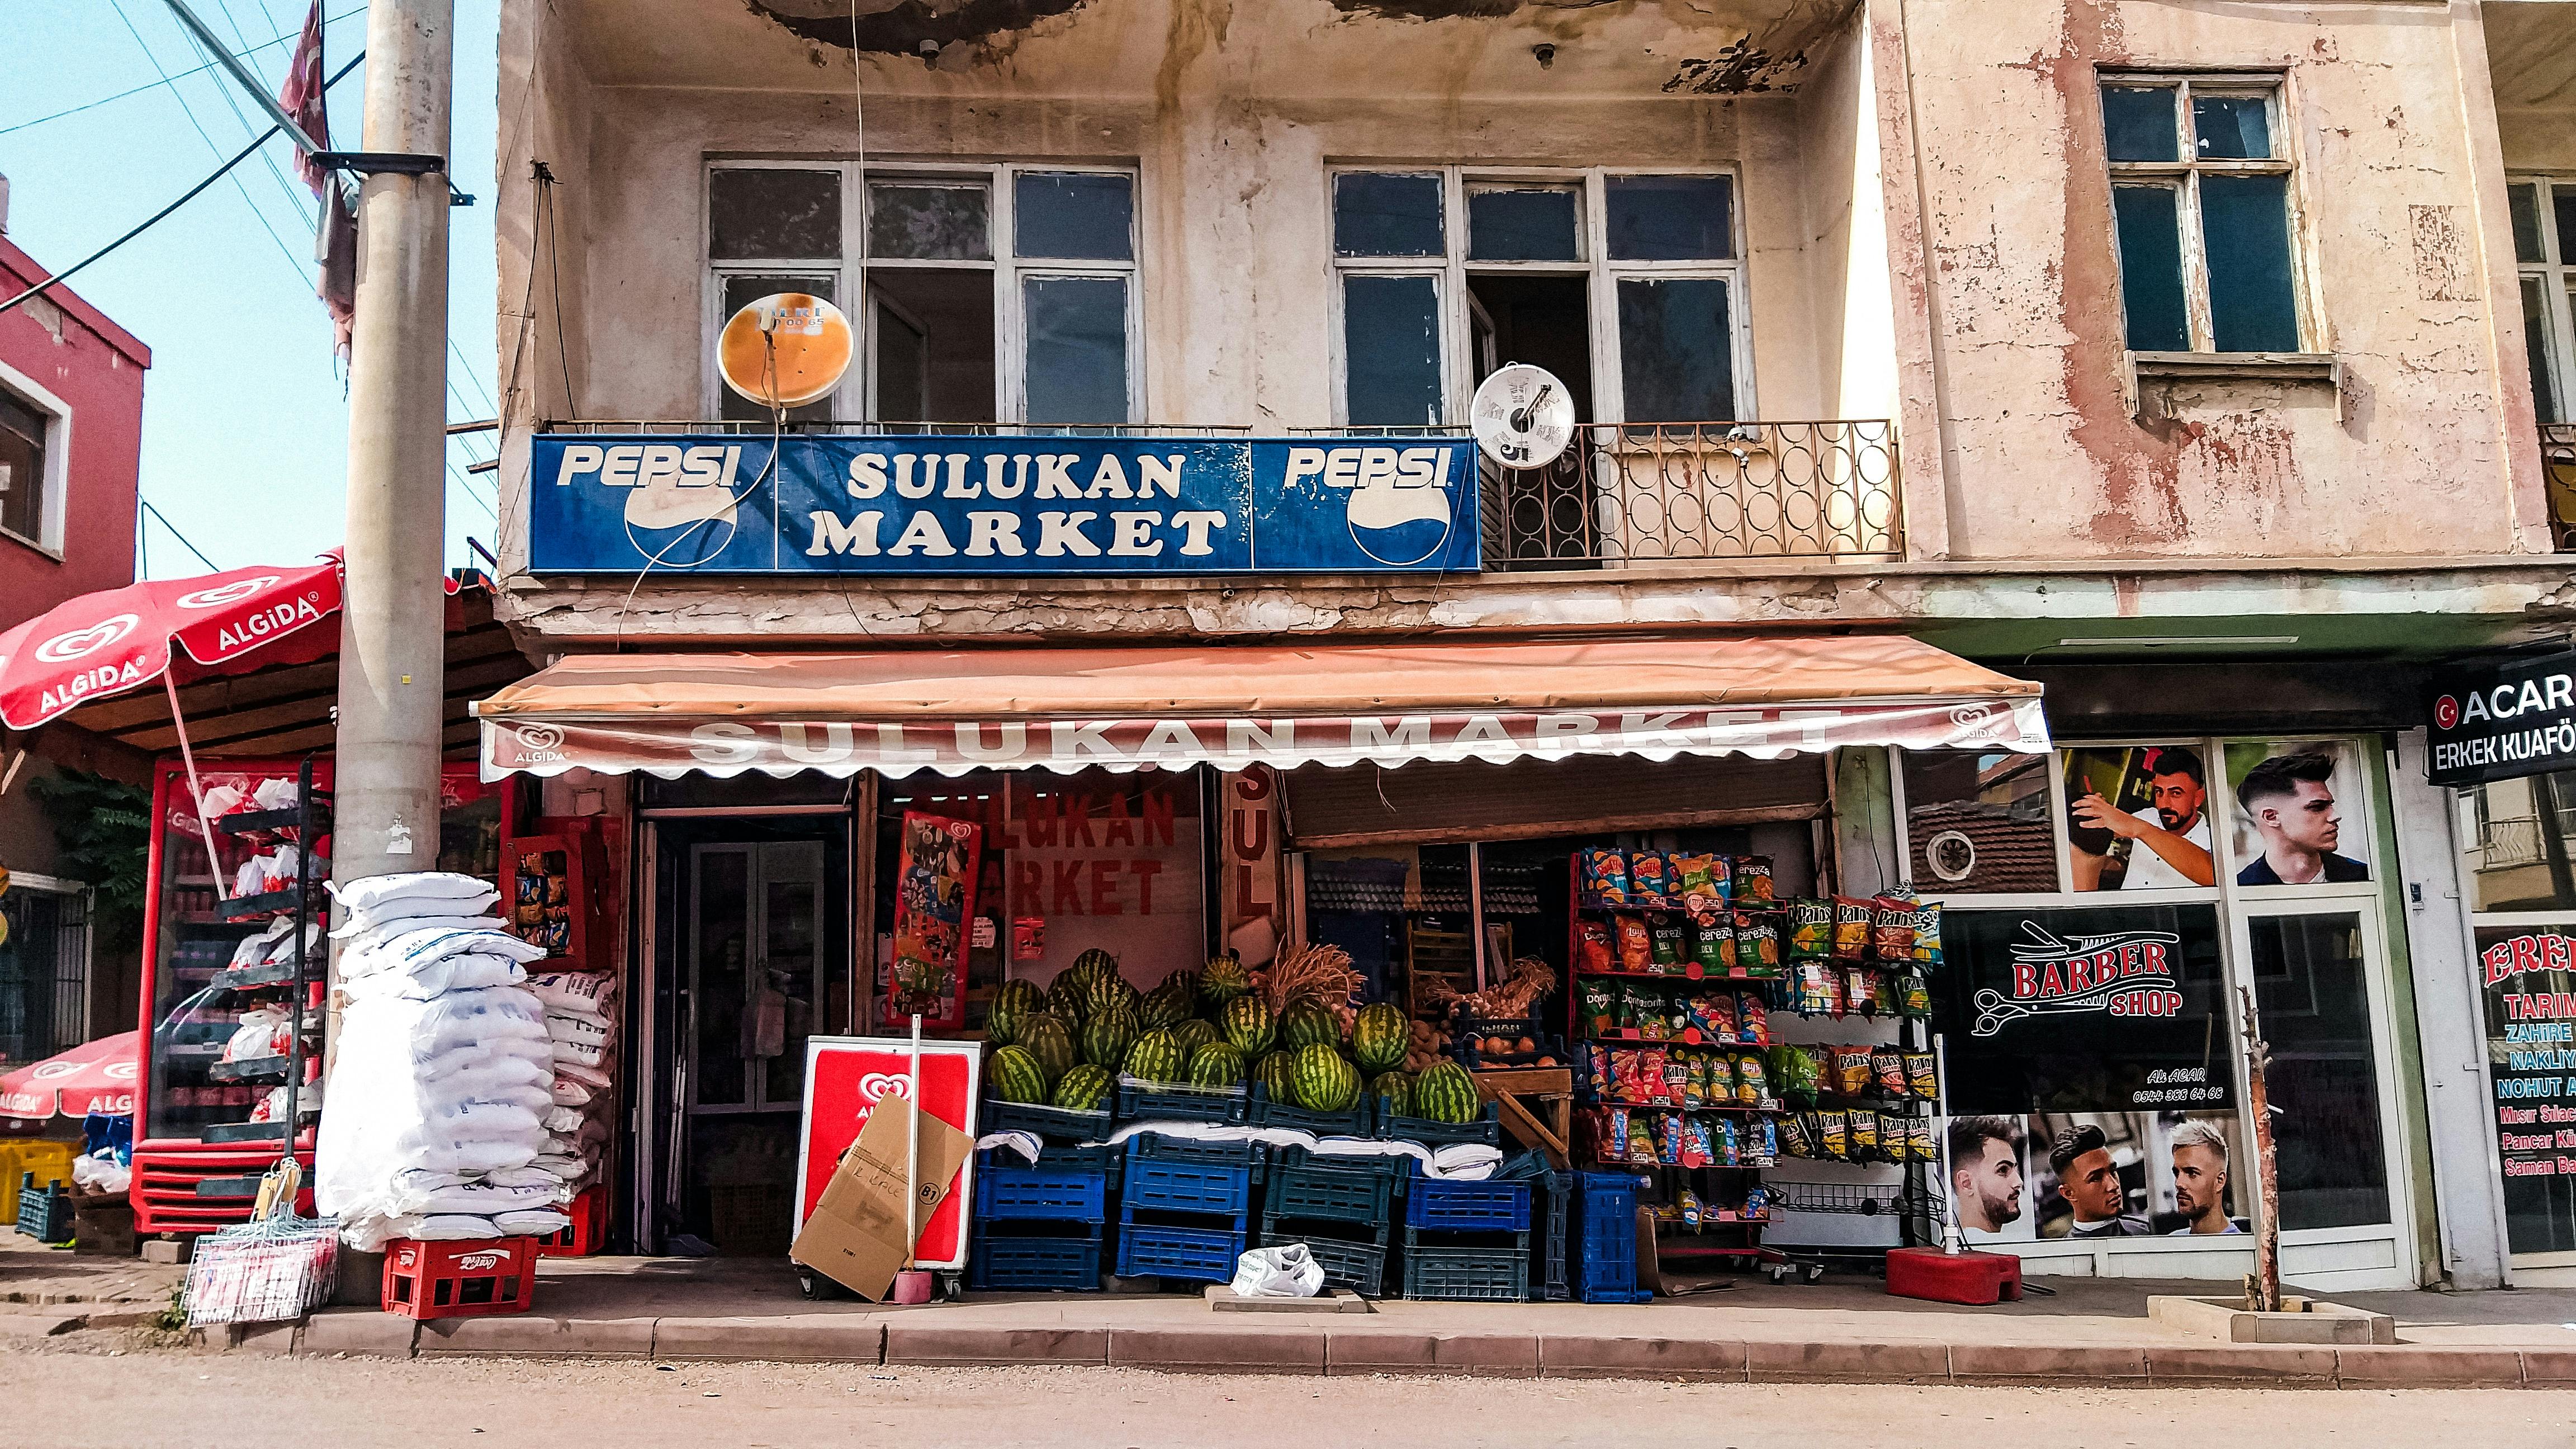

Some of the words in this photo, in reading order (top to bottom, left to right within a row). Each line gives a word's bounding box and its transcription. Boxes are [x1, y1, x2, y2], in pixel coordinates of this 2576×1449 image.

[557, 446, 741, 486] PEPSI
[847, 452, 1187, 500] SULUKAN
[1284, 447, 1452, 488] PEPSI
[806, 510, 1228, 557] MARKET
[2463, 674, 2575, 724] ACAR
[691, 718, 1295, 765] SULUKAN
[1349, 710, 1843, 754] MARKET
[2436, 736, 2498, 770] ERKEK
[2502, 717, 2576, 762] KUAFÖ
[981, 790, 1175, 850] LUKAN
[978, 859, 1162, 917] ARKET
[2012, 943, 2170, 998] BARBER
[2110, 990, 2182, 1017] SHOP
[2503, 992, 2576, 1020] TARIM
[2147, 1069, 2167, 1084] Ali
[2168, 1068, 2206, 1083] ACAR
[2509, 1047, 2576, 1071] NAKLİY
[87, 1095, 132, 1112] ALG
[2133, 1090, 2164, 1103] 0544
[2165, 1088, 2188, 1101] 388
[2190, 1087, 2206, 1100] 64
[2207, 1086, 2223, 1099] 68
[2497, 1077, 2563, 1099] NOHUT
[2502, 1133, 2553, 1150] Pancar
[2555, 1129, 2576, 1148] Kü
[2504, 1157, 2555, 1177] Saman
[2556, 1156, 2576, 1175] Ba
